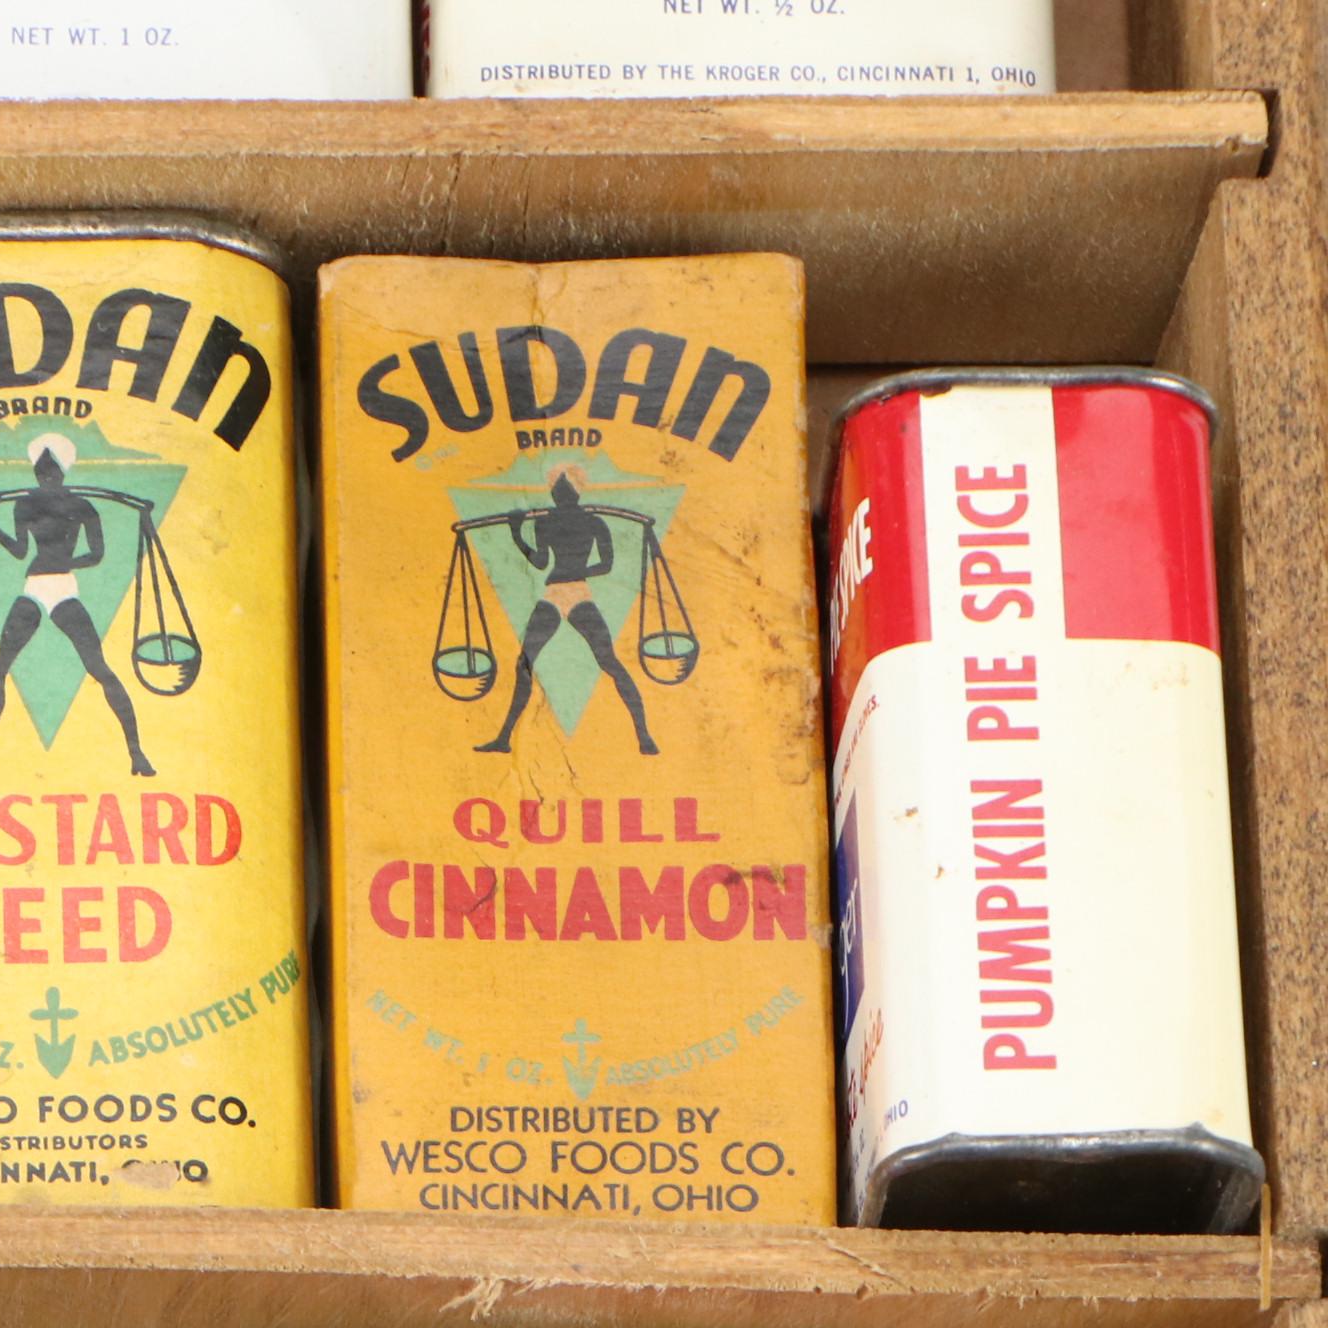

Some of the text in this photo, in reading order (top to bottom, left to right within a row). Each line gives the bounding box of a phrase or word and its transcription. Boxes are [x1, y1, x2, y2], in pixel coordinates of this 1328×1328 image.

[663, 0, 703, 14] NET
[721, 0, 760, 14] WT.
[11, 27, 180, 47] NET WT. 1 OZ.
[480, 65, 1037, 88] DISTRIBUTED BY THE KROGER CO., CINCINNATI OHIO
[357, 325, 771, 463] SUDAN
[516, 427, 602, 450] BRAND
[954, 463, 1057, 1071] PUMPKIN PIE SPICE
[453, 796, 721, 849] QUILL
[368, 859, 808, 942] CINNAMON
[88, 988, 258, 1067] ABSOLUTELY
[258, 948, 301, 1004] PURE
[365, 986, 807, 1087] NET ABSOLUTELY PURE
[38, 1093, 177, 1124] FOODS
[191, 1095, 257, 1129] CO.
[450, 1106, 720, 1134] DISTRIBUTED BY
[381, 1141, 796, 1176] WESCO FOODS CO.
[419, 1183, 759, 1216] CINCINNATI, OHIO
